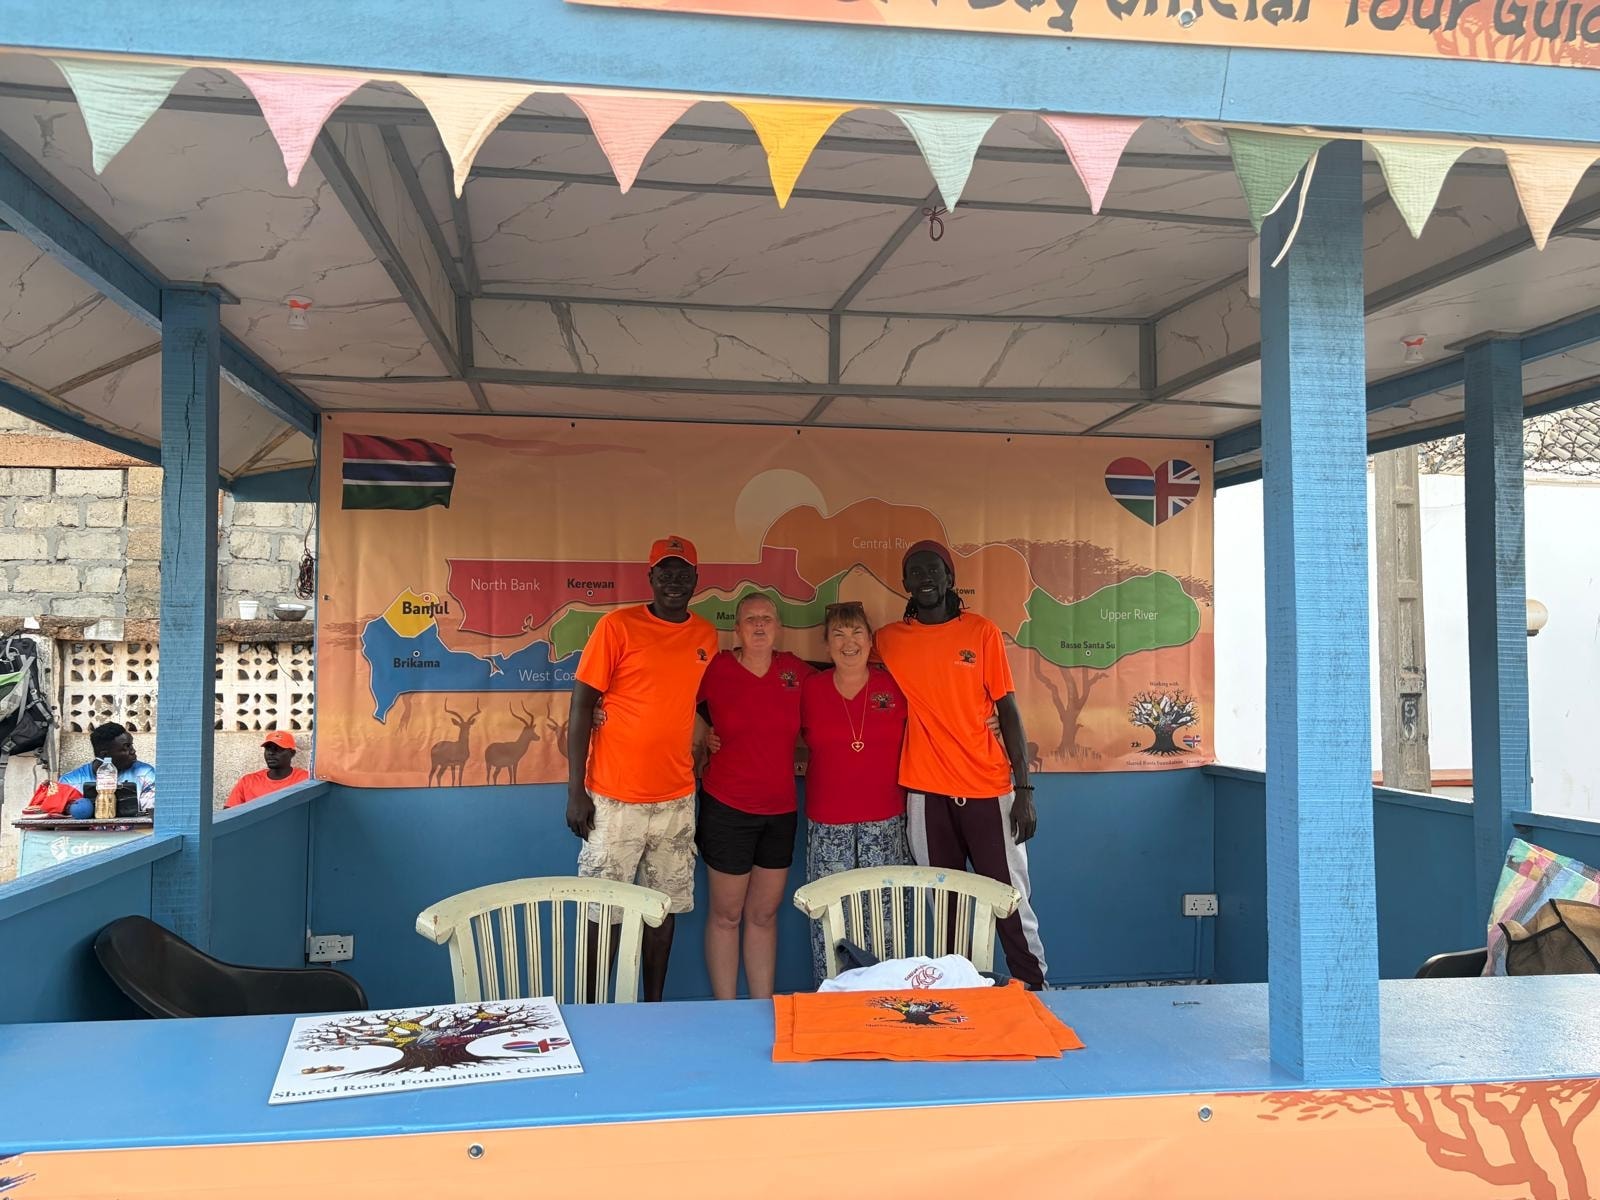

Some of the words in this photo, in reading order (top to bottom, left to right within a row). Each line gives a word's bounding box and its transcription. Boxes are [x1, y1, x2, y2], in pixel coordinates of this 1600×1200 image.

[852, 536, 891, 550] Central
[470, 577, 506, 592] North
[511, 578, 540, 592] Bank
[567, 578, 615, 590] Kerewan
[402, 601, 449, 619] Banjul
[1100, 607, 1132, 623] Upper
[1134, 608, 1158, 621] River
[1083, 641, 1105, 649] Santa
[1106, 641, 1116, 649] Su
[393, 657, 440, 668] Brikama
[518, 669, 551, 682] West
[554, 669, 577, 682] Coa
[273, 1086, 338, 1098] Shared
[343, 1081, 396, 1092] Roots
[401, 1071, 501, 1086] Foundation
[516, 1063, 582, 1074] Gambia
